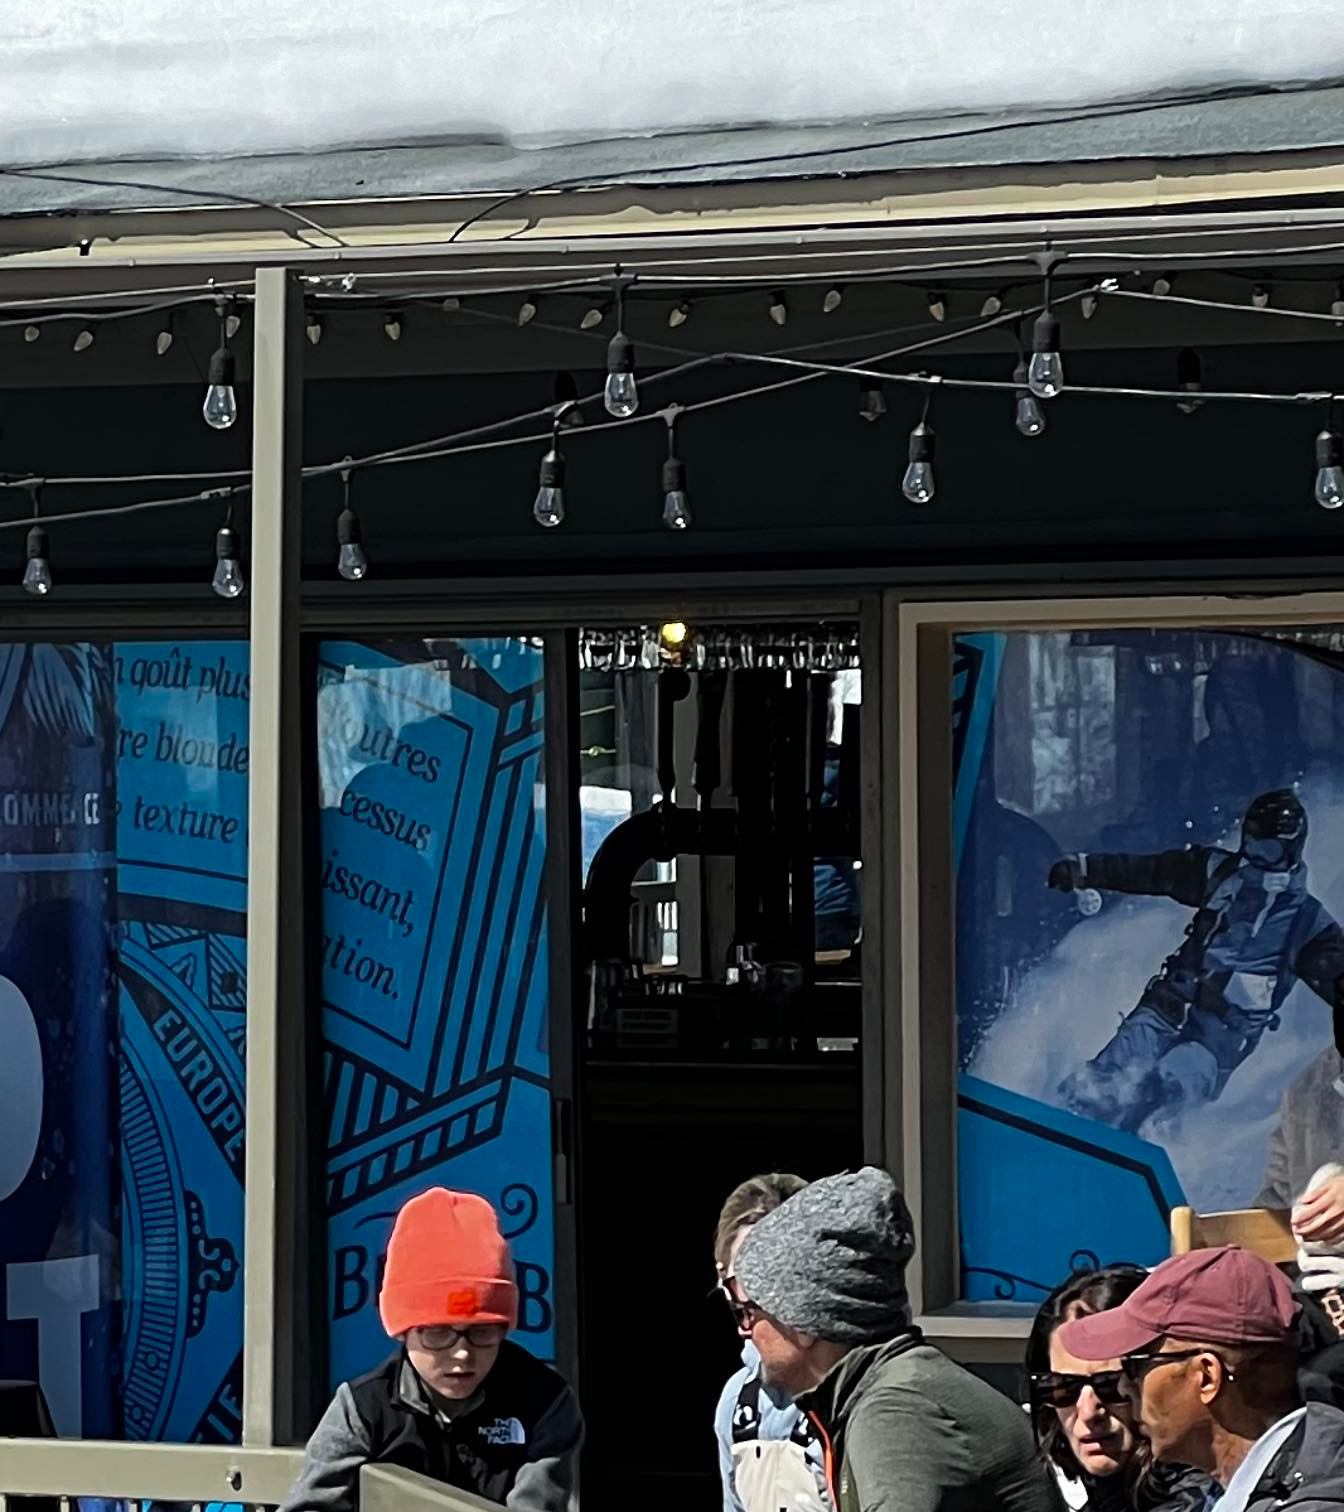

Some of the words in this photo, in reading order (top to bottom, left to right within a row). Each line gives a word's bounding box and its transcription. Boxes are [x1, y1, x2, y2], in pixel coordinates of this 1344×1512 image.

[155, 720, 248, 773] blonde
[133, 794, 238, 843] texture
[153, 1008, 245, 1162] EUROPE
